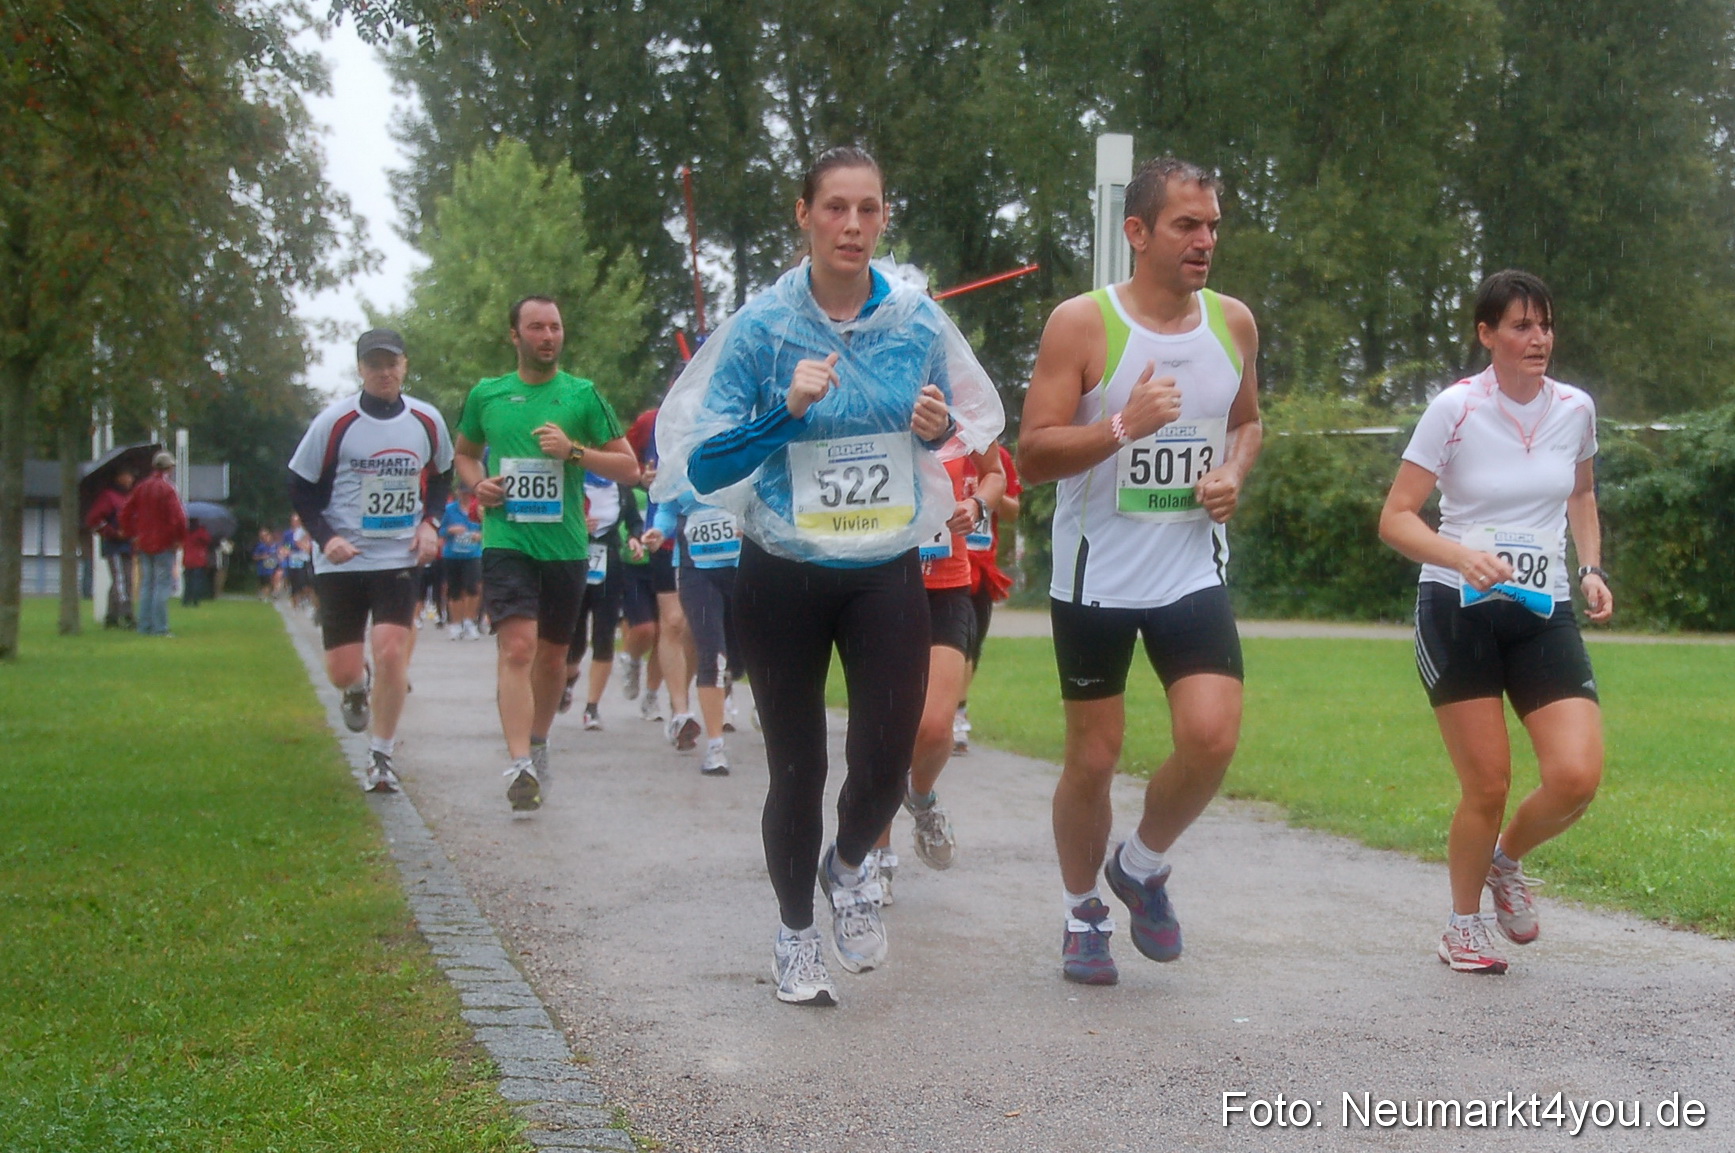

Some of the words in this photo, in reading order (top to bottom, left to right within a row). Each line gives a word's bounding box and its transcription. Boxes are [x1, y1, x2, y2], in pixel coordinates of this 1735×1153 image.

[350, 458, 411, 469] GERHART
[1129, 446, 1214, 485] 5013
[505, 475, 558, 499] 2865
[818, 464, 890, 508] 522
[368, 492, 416, 515] 3245
[690, 520, 734, 543] 2855
